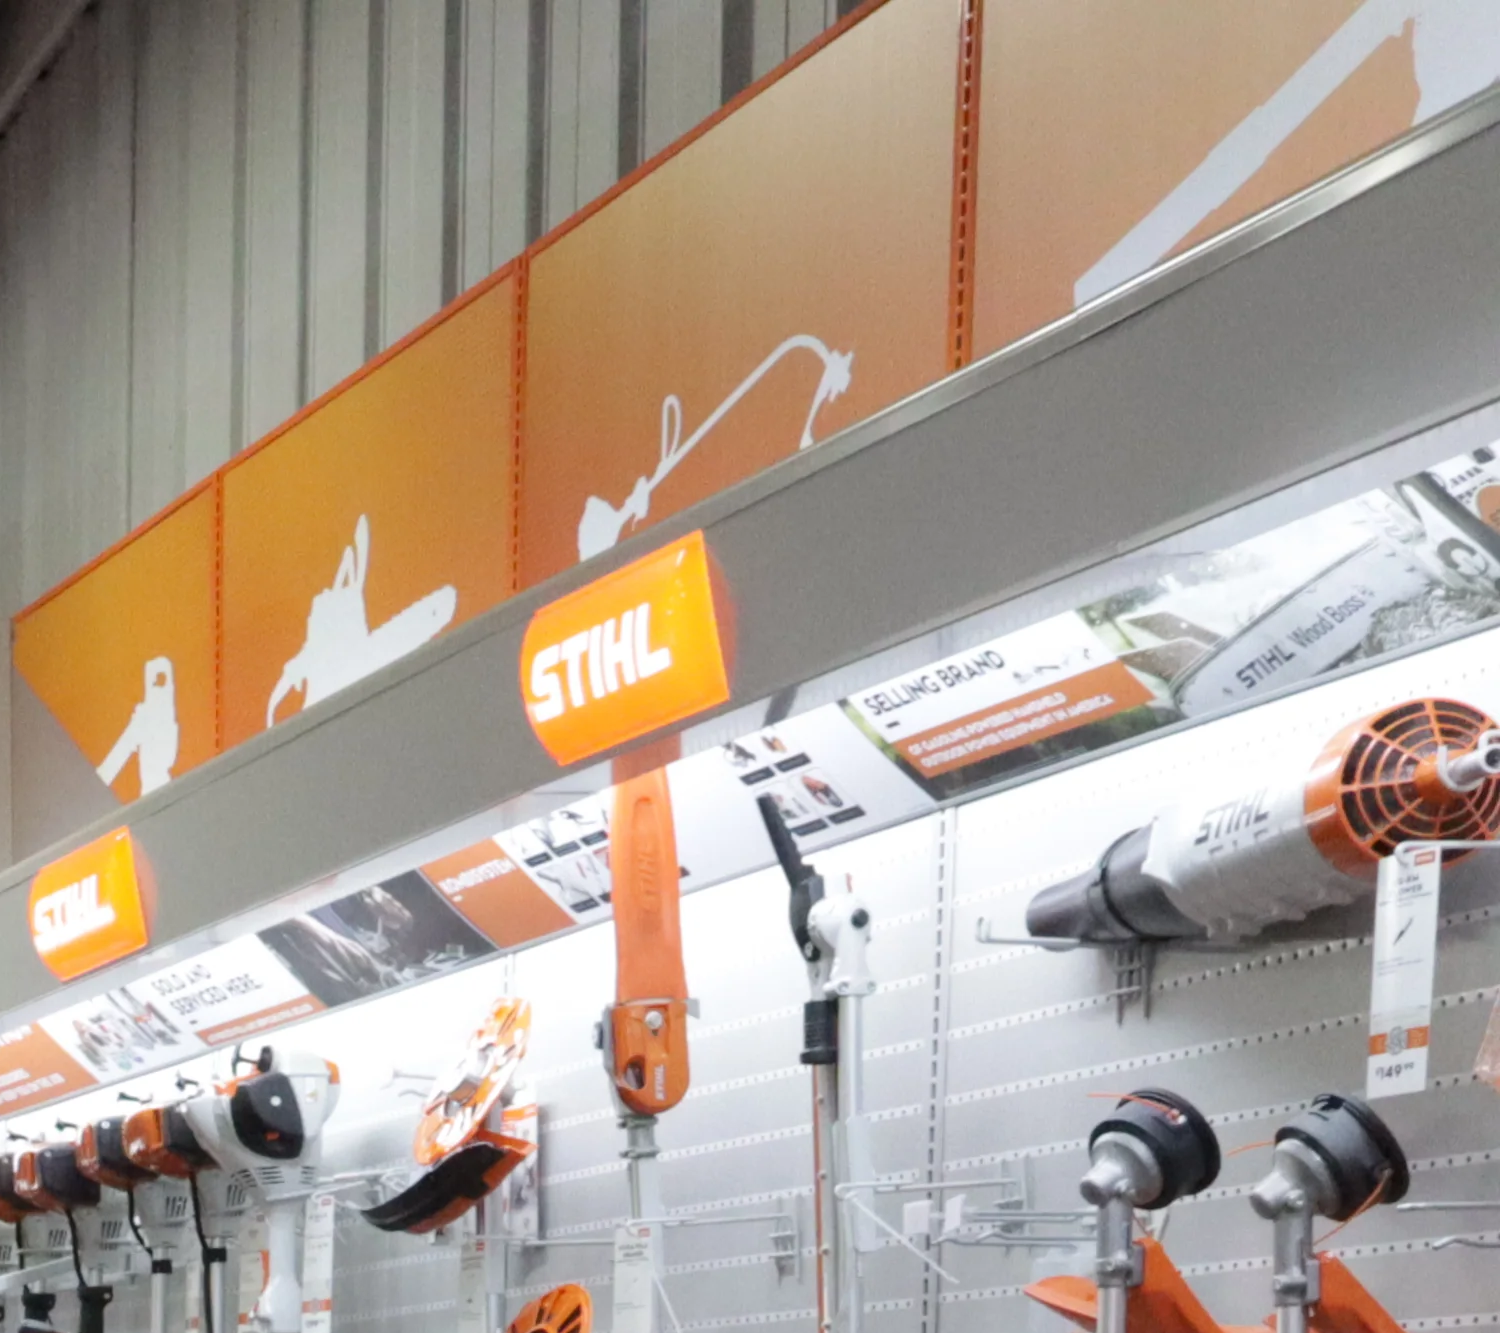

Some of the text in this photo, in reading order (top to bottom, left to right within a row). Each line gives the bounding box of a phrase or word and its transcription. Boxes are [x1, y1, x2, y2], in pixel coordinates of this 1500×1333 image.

[530, 603, 672, 722] STIHL
[1236, 592, 1367, 689] STIHL Wood Boss
[864, 650, 1006, 716] SELLING BRAND
[1194, 786, 1270, 846] STIHL
[32, 874, 116, 951] STIHL
[170, 986, 228, 1016] SERVICED
